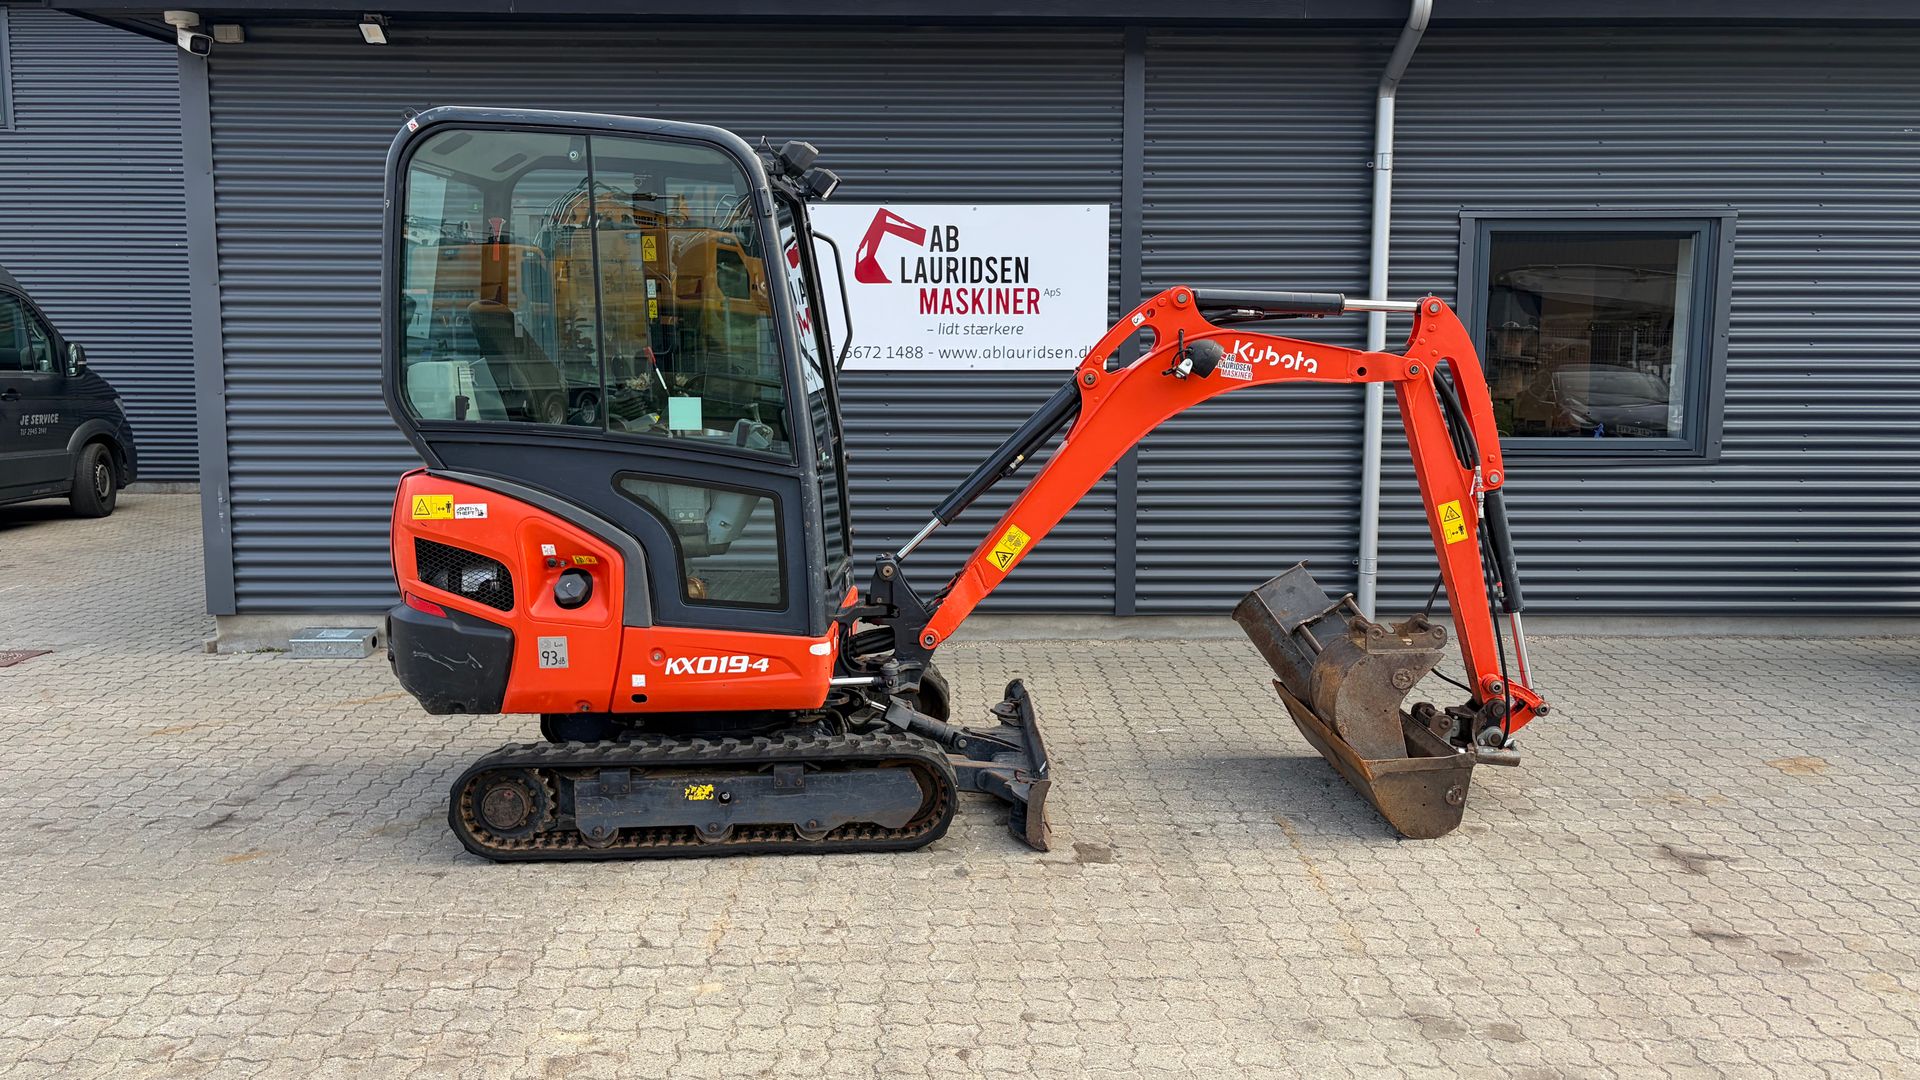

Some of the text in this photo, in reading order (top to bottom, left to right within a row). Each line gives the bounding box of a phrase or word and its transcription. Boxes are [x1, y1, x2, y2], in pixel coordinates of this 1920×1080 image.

[929, 225, 960, 252] AB
[900, 256, 1029, 284] LAURIDSEN
[919, 287, 1062, 315] MASKINER ApS
[938, 323, 959, 336] lidt
[963, 323, 1024, 336] stærkere
[886, 345, 924, 359] 1488
[1226, 354, 1236, 362] AB
[1233, 340, 1318, 374] Kubota
[1222, 368, 1252, 380] MASKINER
[20, 413, 59, 426] JE SERVICE
[541, 650, 558, 666] 93
[665, 655, 770, 676] KX019-4
